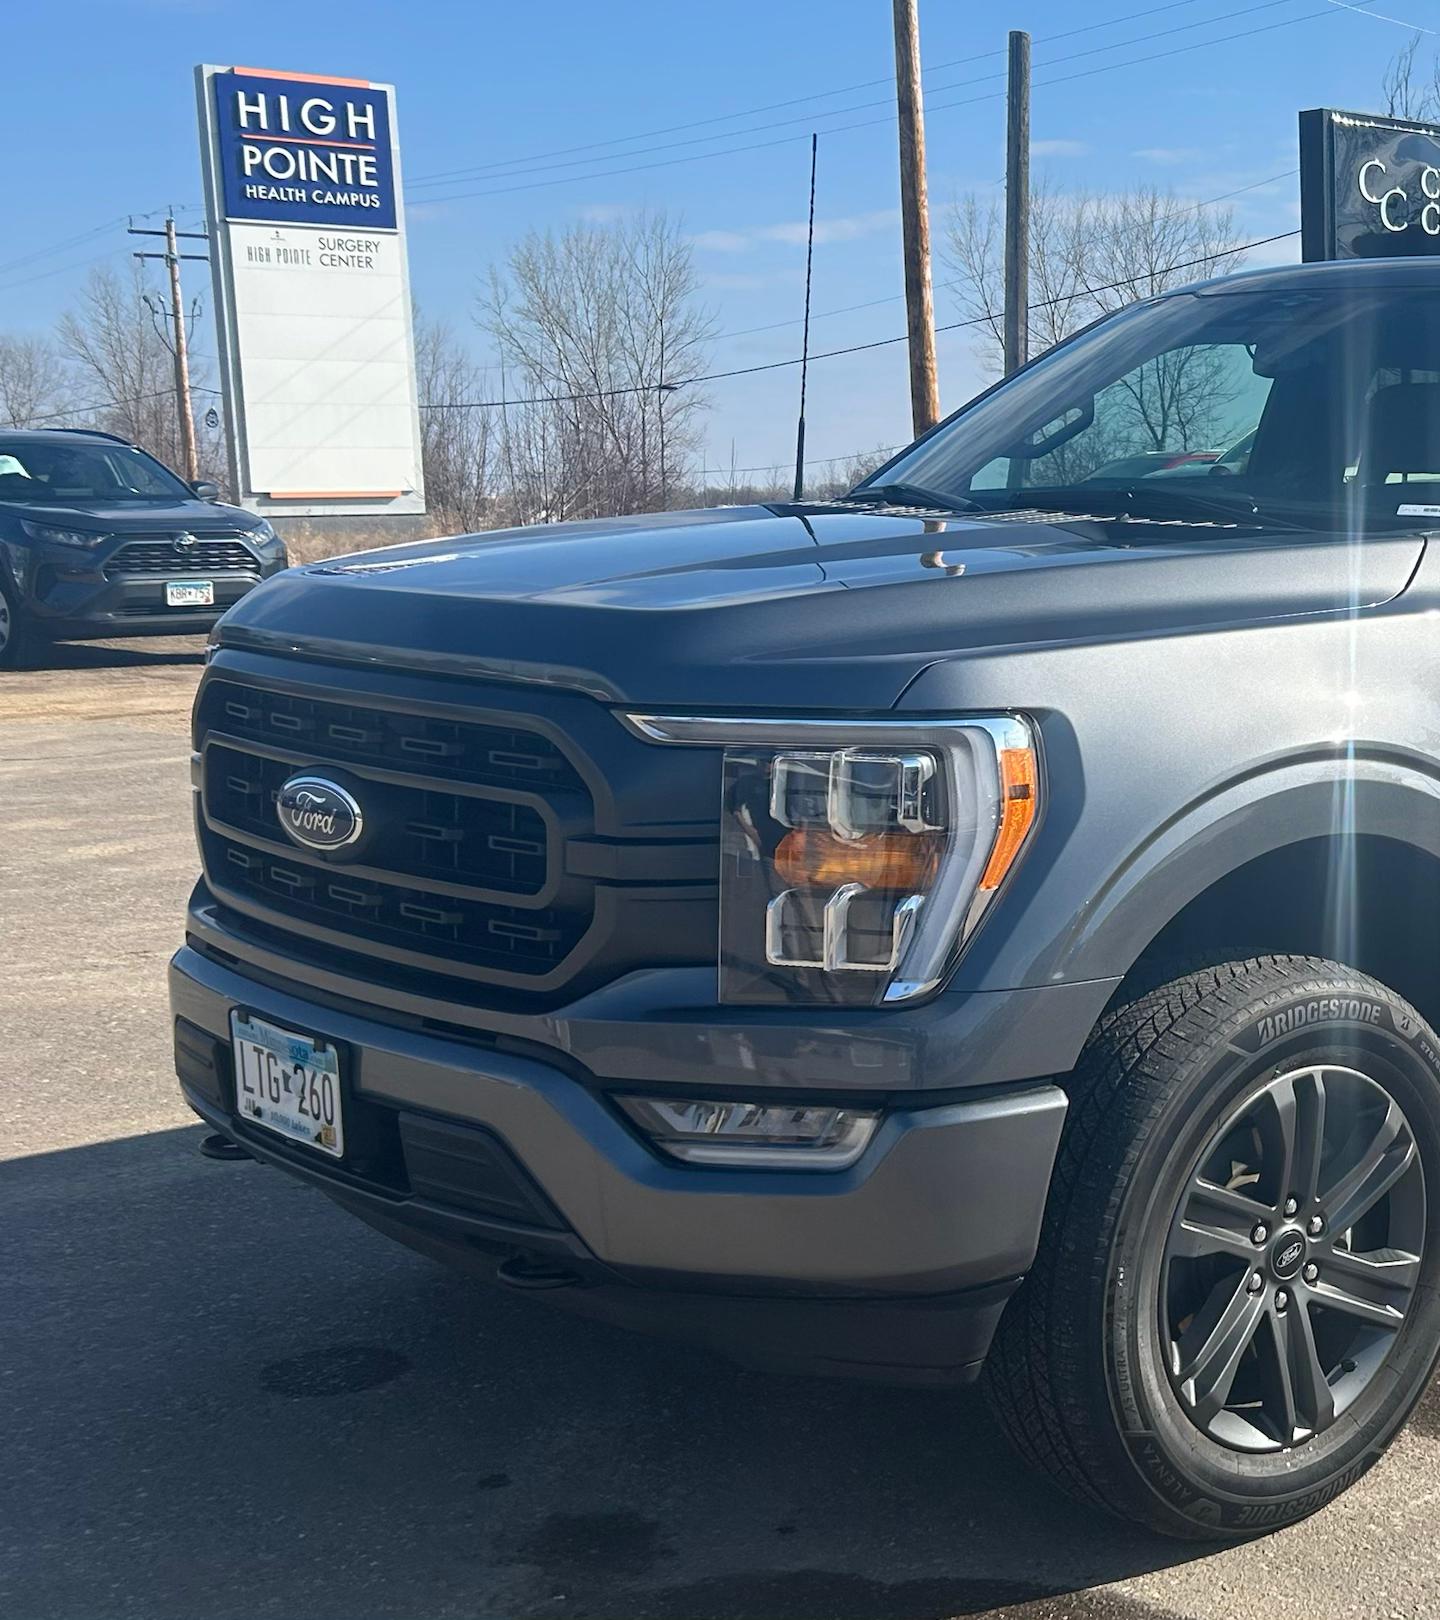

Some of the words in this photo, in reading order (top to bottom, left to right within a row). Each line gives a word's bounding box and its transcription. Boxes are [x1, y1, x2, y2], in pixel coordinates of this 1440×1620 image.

[236, 90, 376, 140] HIGH
[243, 144, 378, 187] POINTE
[246, 185, 307, 203] HEALTH
[312, 189, 380, 208] CAMPUS
[247, 246, 271, 263] HIGH
[276, 247, 312, 265] POINTE
[318, 237, 381, 254] SURGERY
[319, 253, 373, 269] CENTER
[291, 791, 338, 834] Ford
[1257, 999, 1382, 1047] BRIDGESTONE
[239, 1041, 281, 1104] LTG
[293, 1063, 335, 1126] 260
